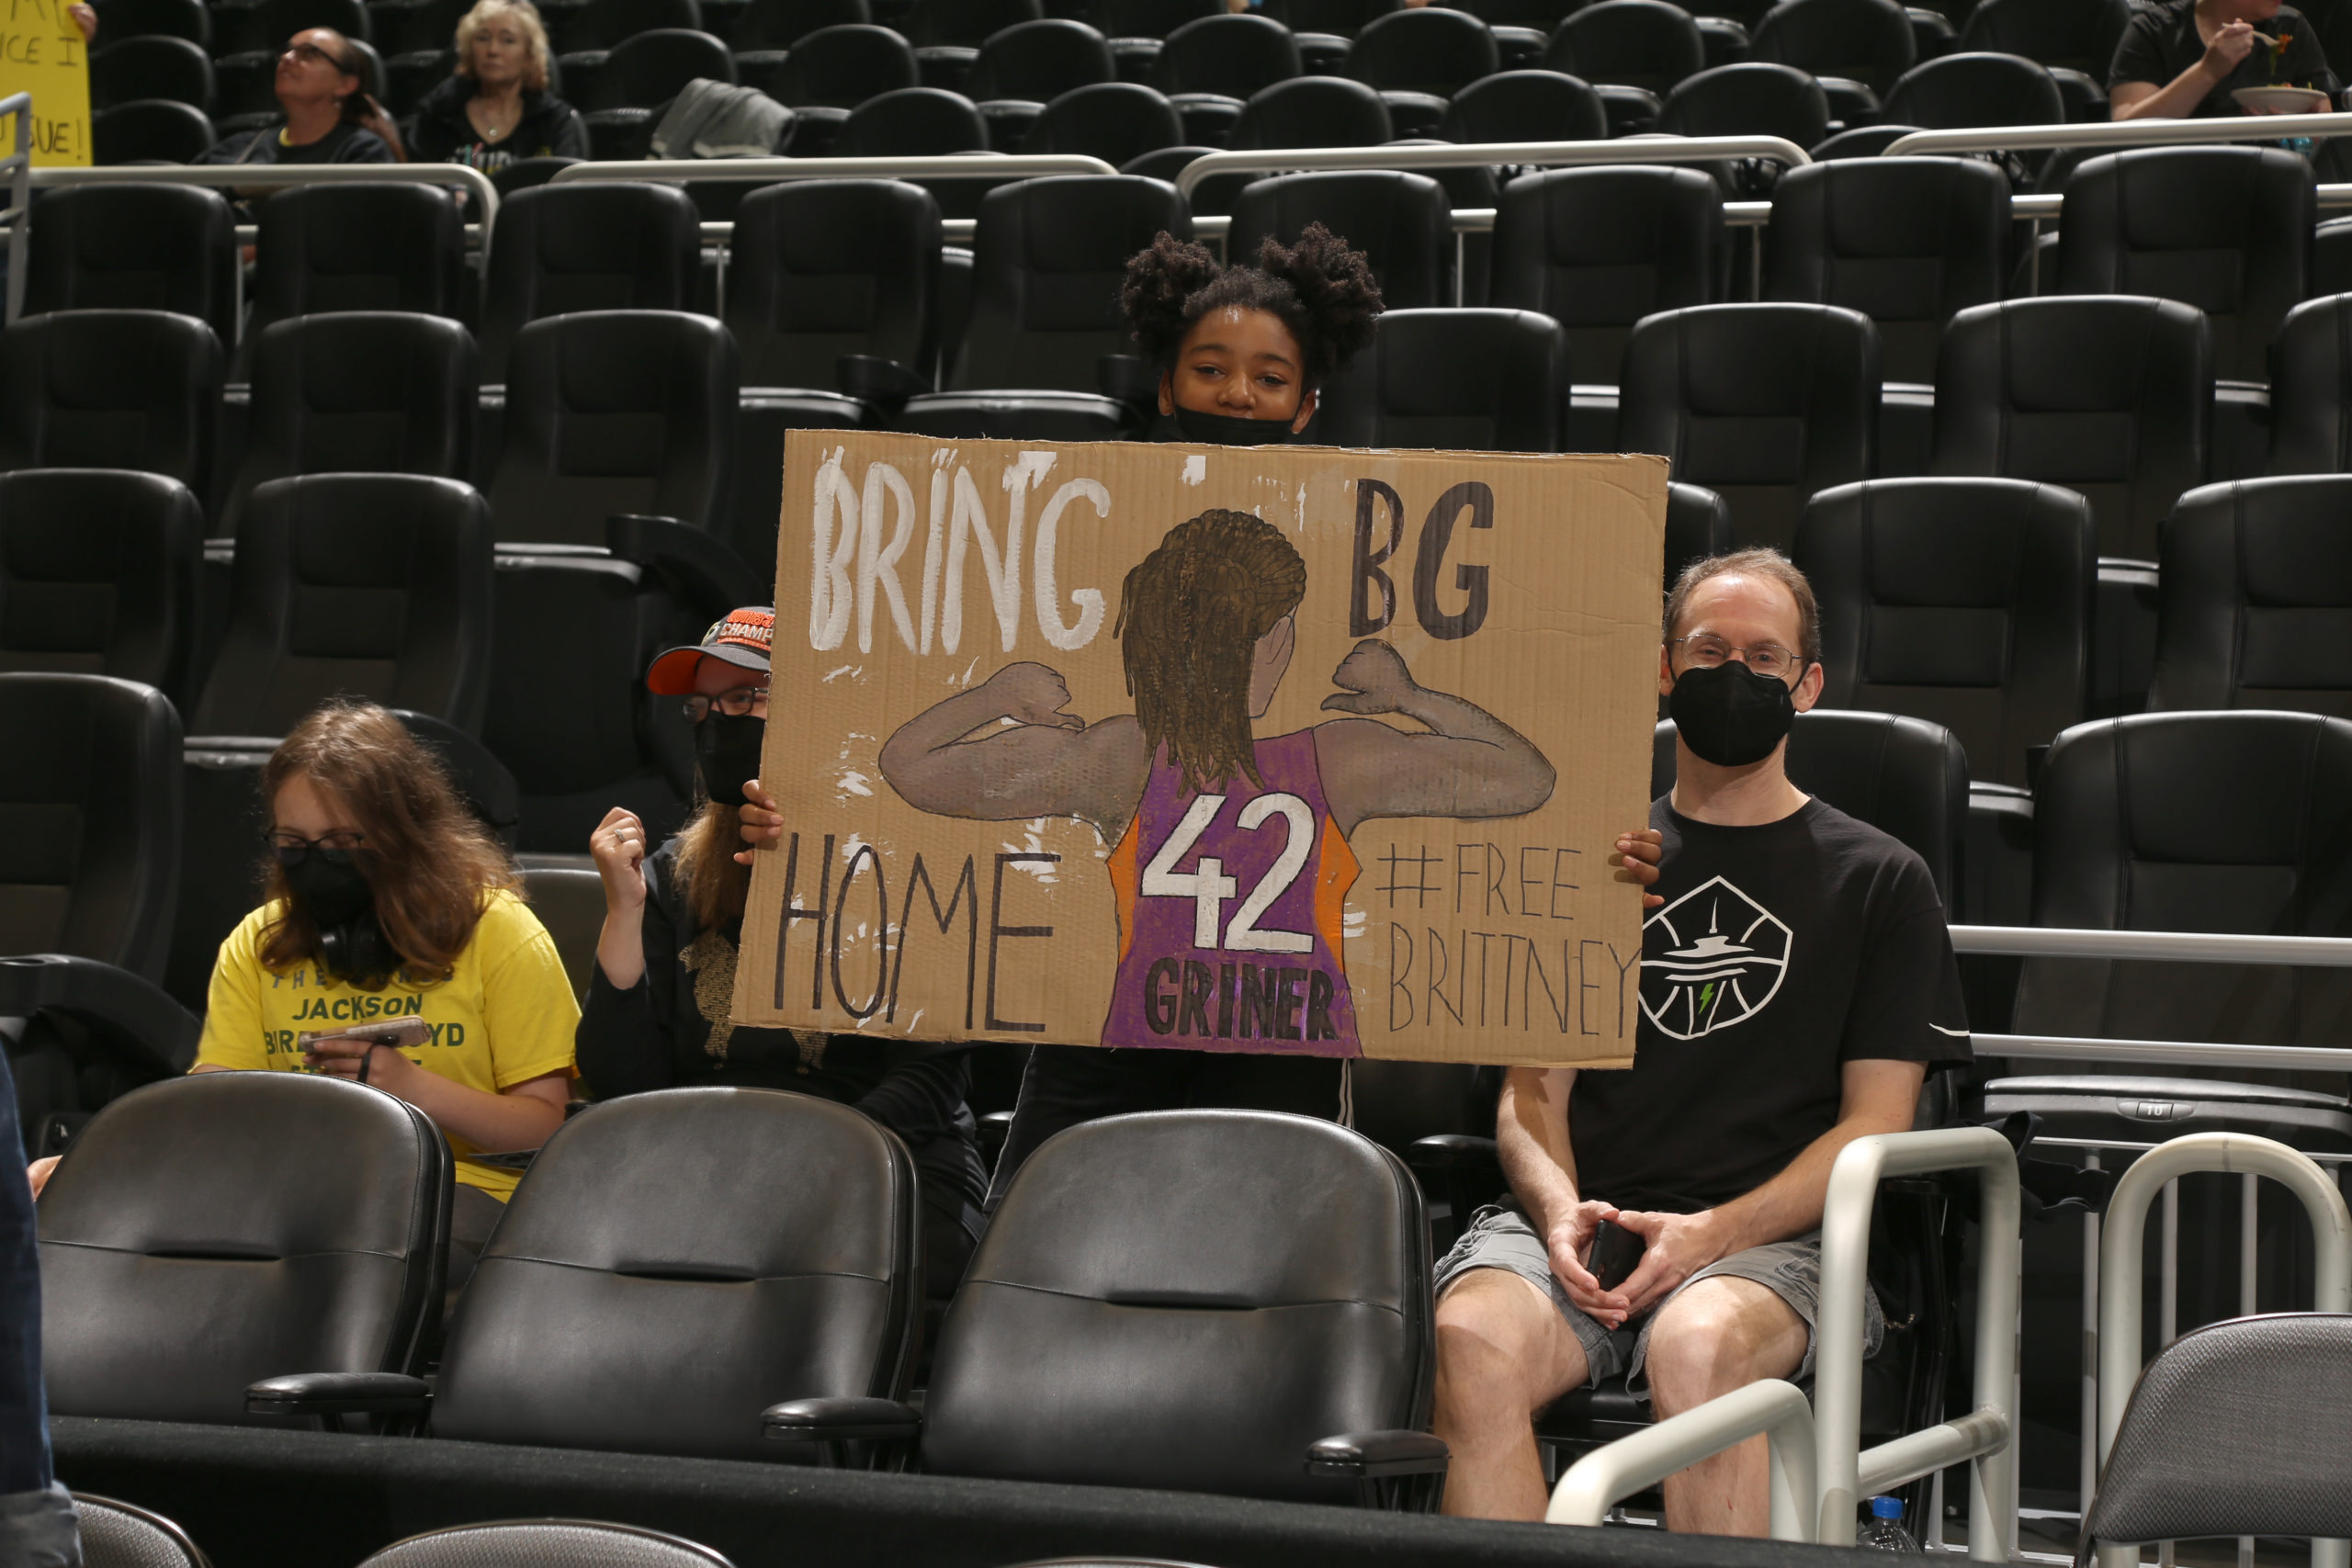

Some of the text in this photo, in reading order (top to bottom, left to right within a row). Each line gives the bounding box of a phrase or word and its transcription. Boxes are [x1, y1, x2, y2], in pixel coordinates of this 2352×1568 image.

[56, 37, 79, 66] I
[809, 456, 1495, 656] BRING BG
[1139, 791, 1317, 954] 42
[1374, 842, 1582, 920] #FREE
[774, 831, 1062, 1033] HOME
[272, 967, 328, 990] THE
[291, 993, 424, 1021] JACKSON
[1144, 957, 1339, 1041] GRINER
[1389, 920, 1643, 1039] BRITTNEY
